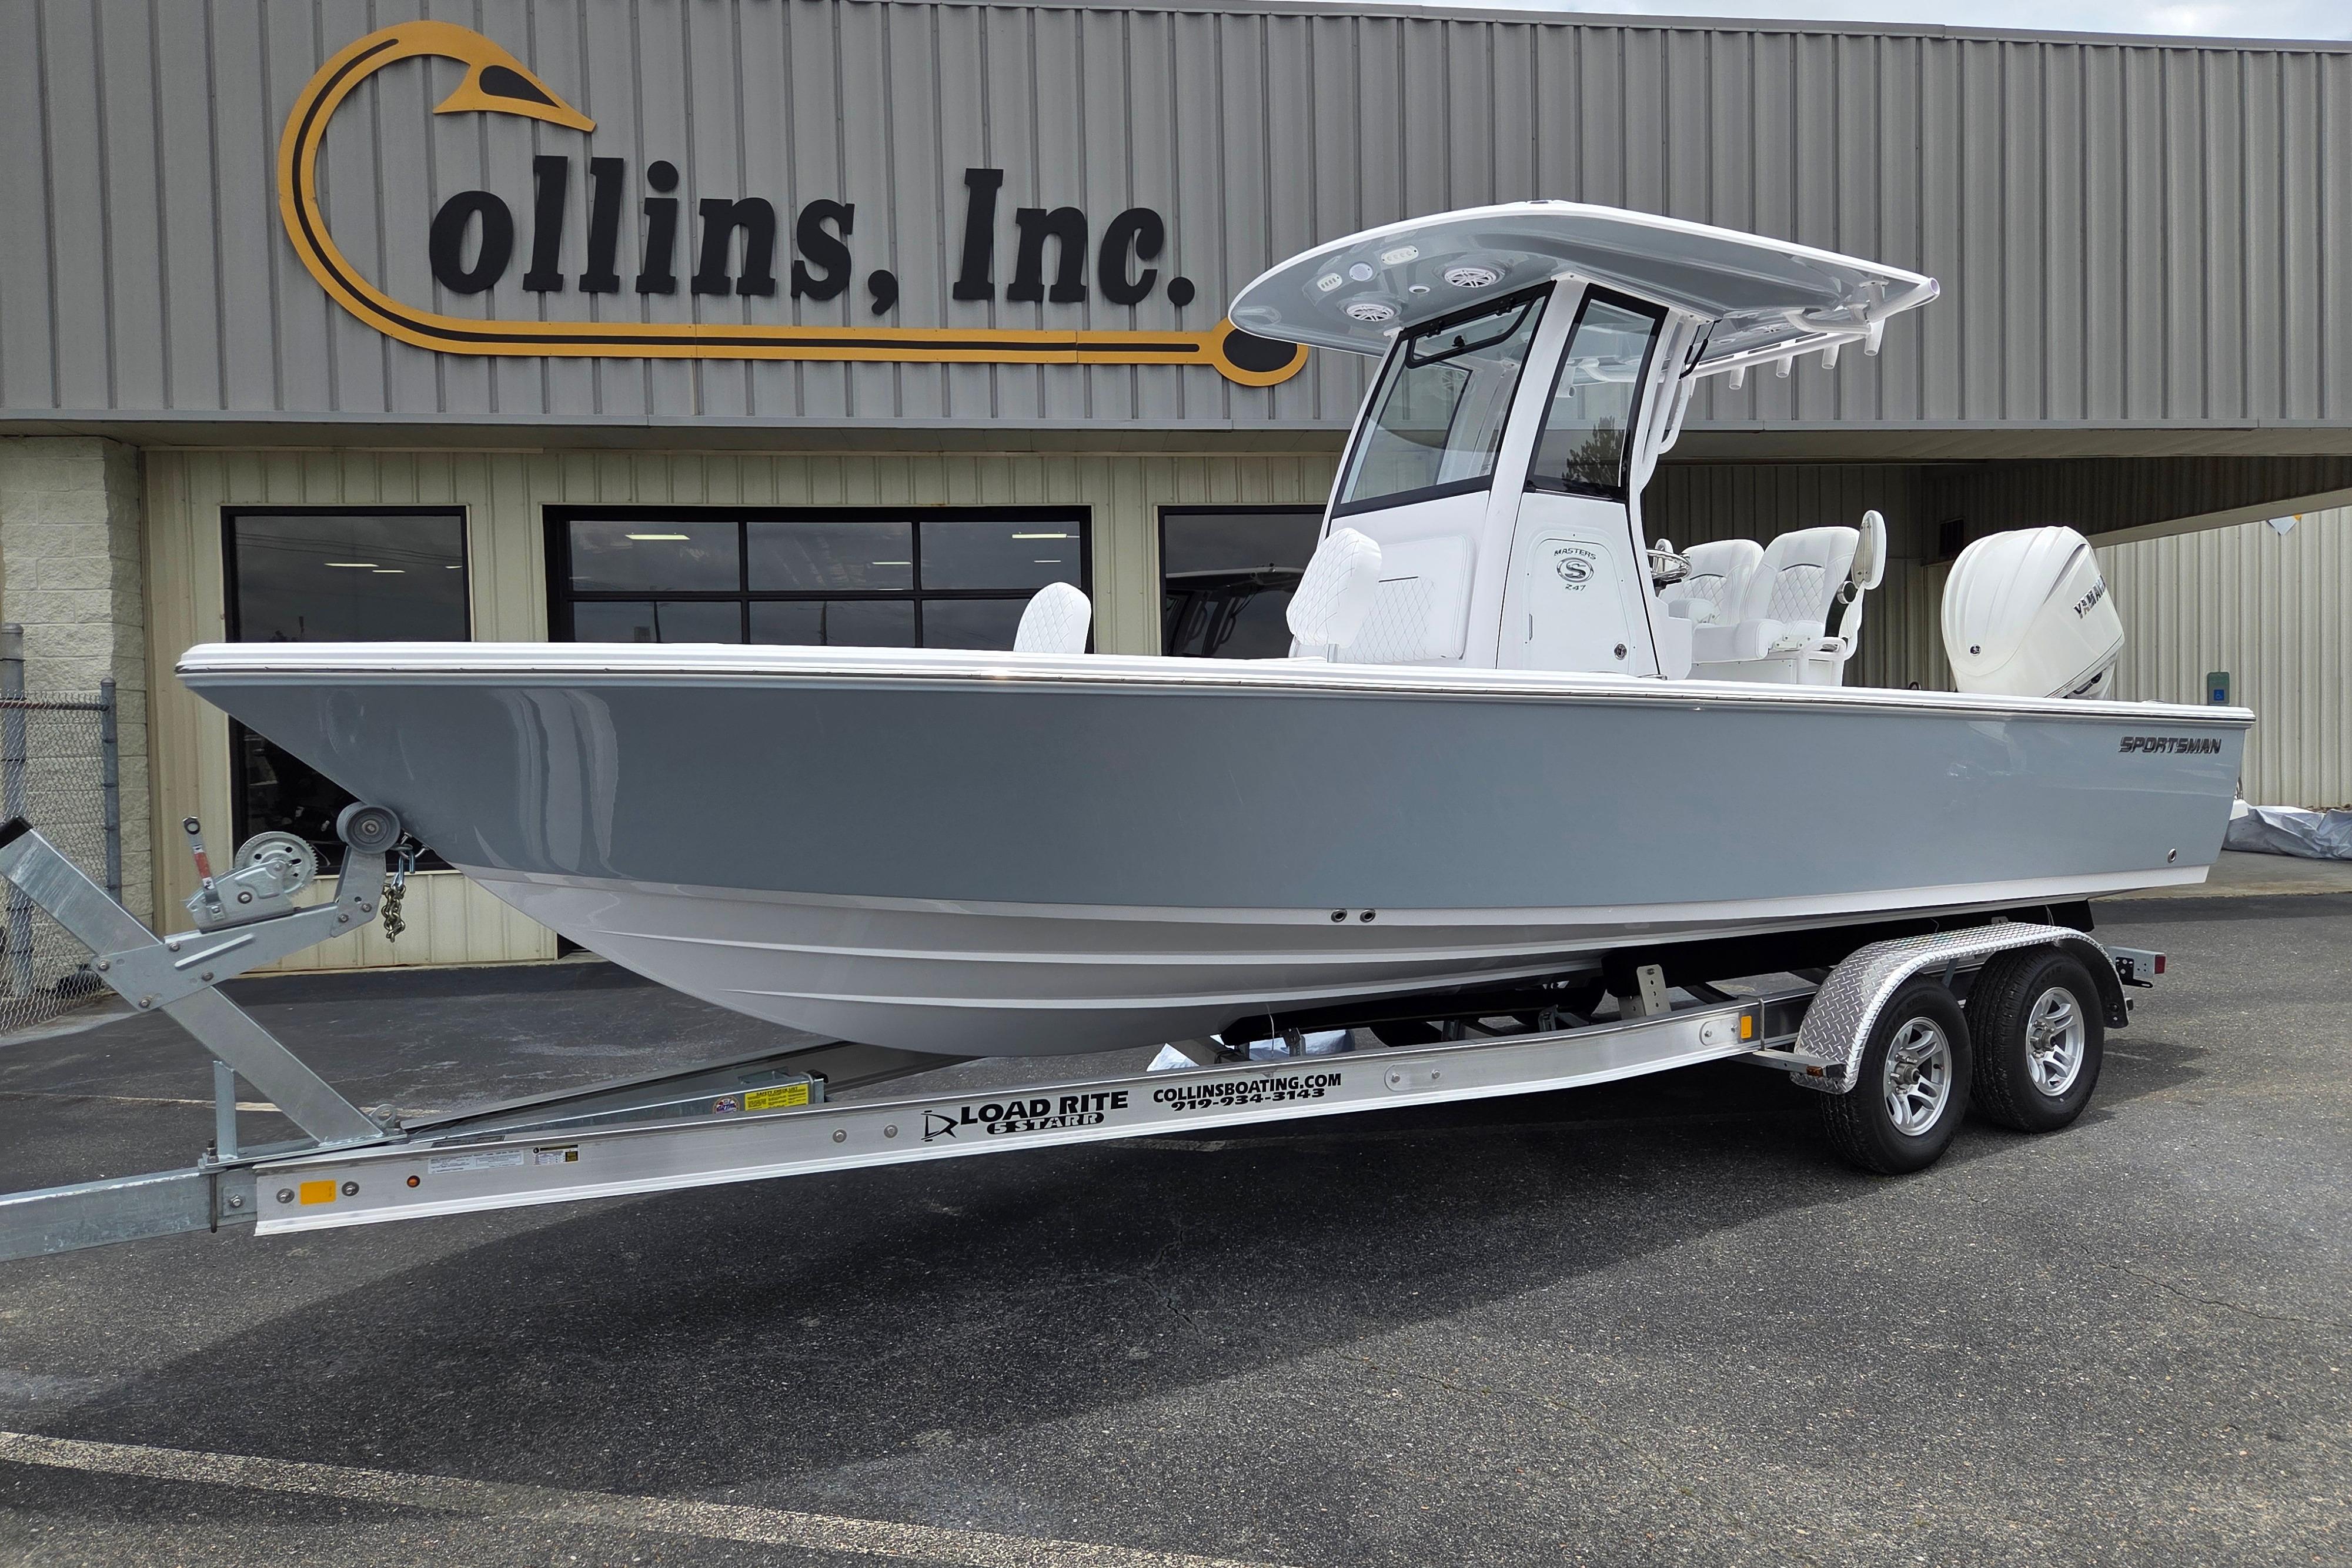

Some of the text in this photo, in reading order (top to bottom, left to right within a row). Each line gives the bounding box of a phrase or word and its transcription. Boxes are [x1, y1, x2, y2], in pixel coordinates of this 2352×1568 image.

[953, 168, 1195, 307] Inc.
[1554, 547, 1596, 560] MASTERS
[2073, 574, 2106, 619] YAMAH
[2118, 736, 2222, 754] SPORTSMAN
[1153, 1073, 1341, 1103] COLLINSBOATING.COM
[1171, 1088, 1325, 1112] 919-934-3143
[960, 1091, 1129, 1125] LOAD RITE
[994, 1112, 1098, 1134] 5 STARR
